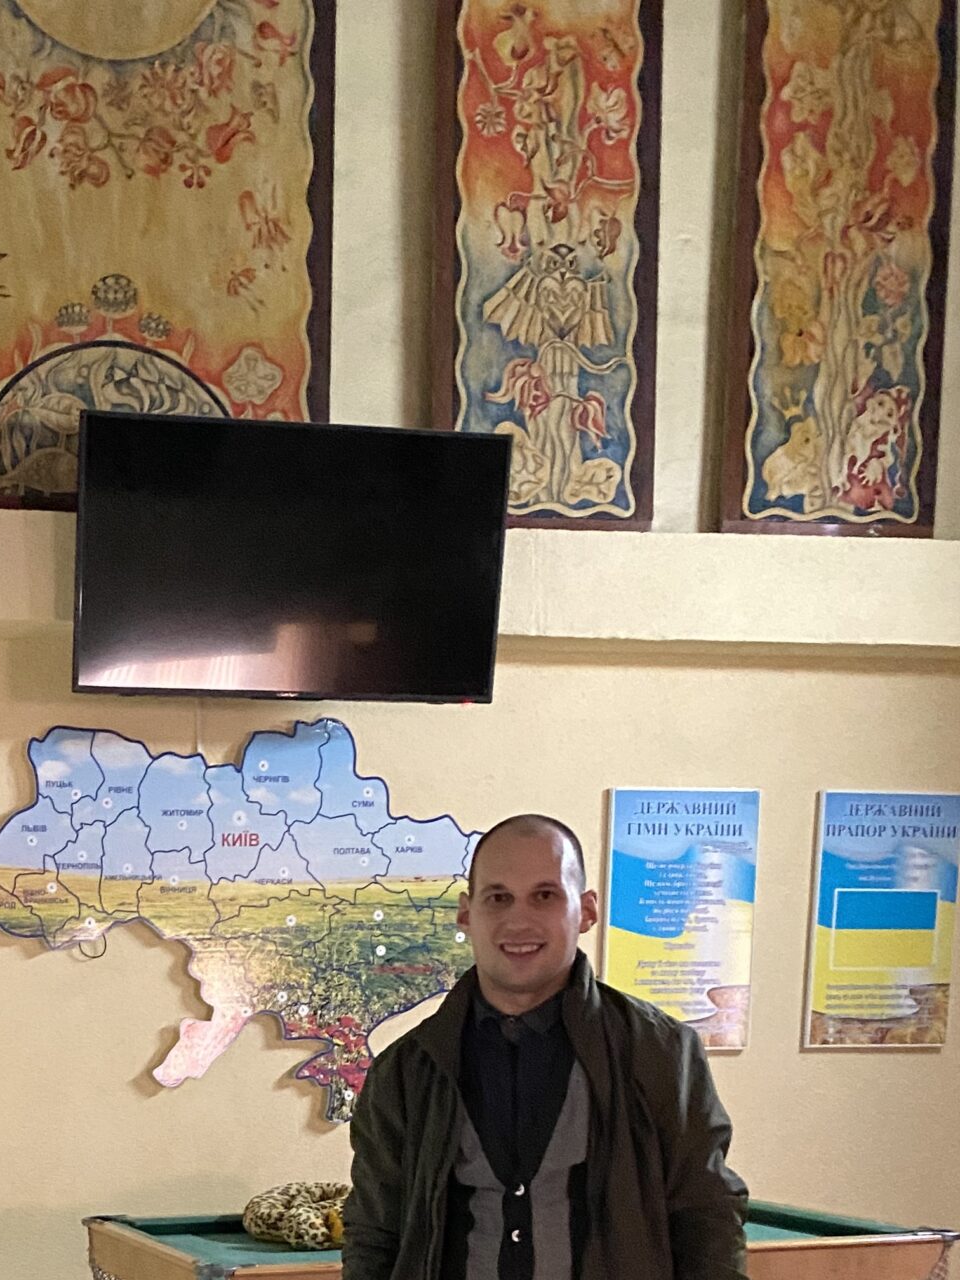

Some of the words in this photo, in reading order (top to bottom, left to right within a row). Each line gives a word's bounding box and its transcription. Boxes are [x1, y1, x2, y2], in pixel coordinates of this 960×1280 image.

[107, 786, 133, 794] РІВНЕ
[351, 800, 374, 808] СУМИ
[634, 799, 738, 817] ДЕРЖАВНИЙ
[161, 809, 204, 817] ЖИТОМИР
[844, 801, 942, 818] ДЕРЖАВНИЙ
[21, 825, 48, 833] ЛЬВІВ
[626, 821, 669, 836] ГІМН
[672, 821, 744, 838] УКРАЇНИ
[826, 823, 886, 837] ПРАПОР
[890, 824, 958, 839] УКРАЇНИ
[221, 830, 260, 847] КИЇВ
[333, 847, 371, 855] ПОЛТАВА
[394, 845, 423, 853] ХАРКІВ
[58, 862, 101, 870] ТЕРНОПІЛЬ
